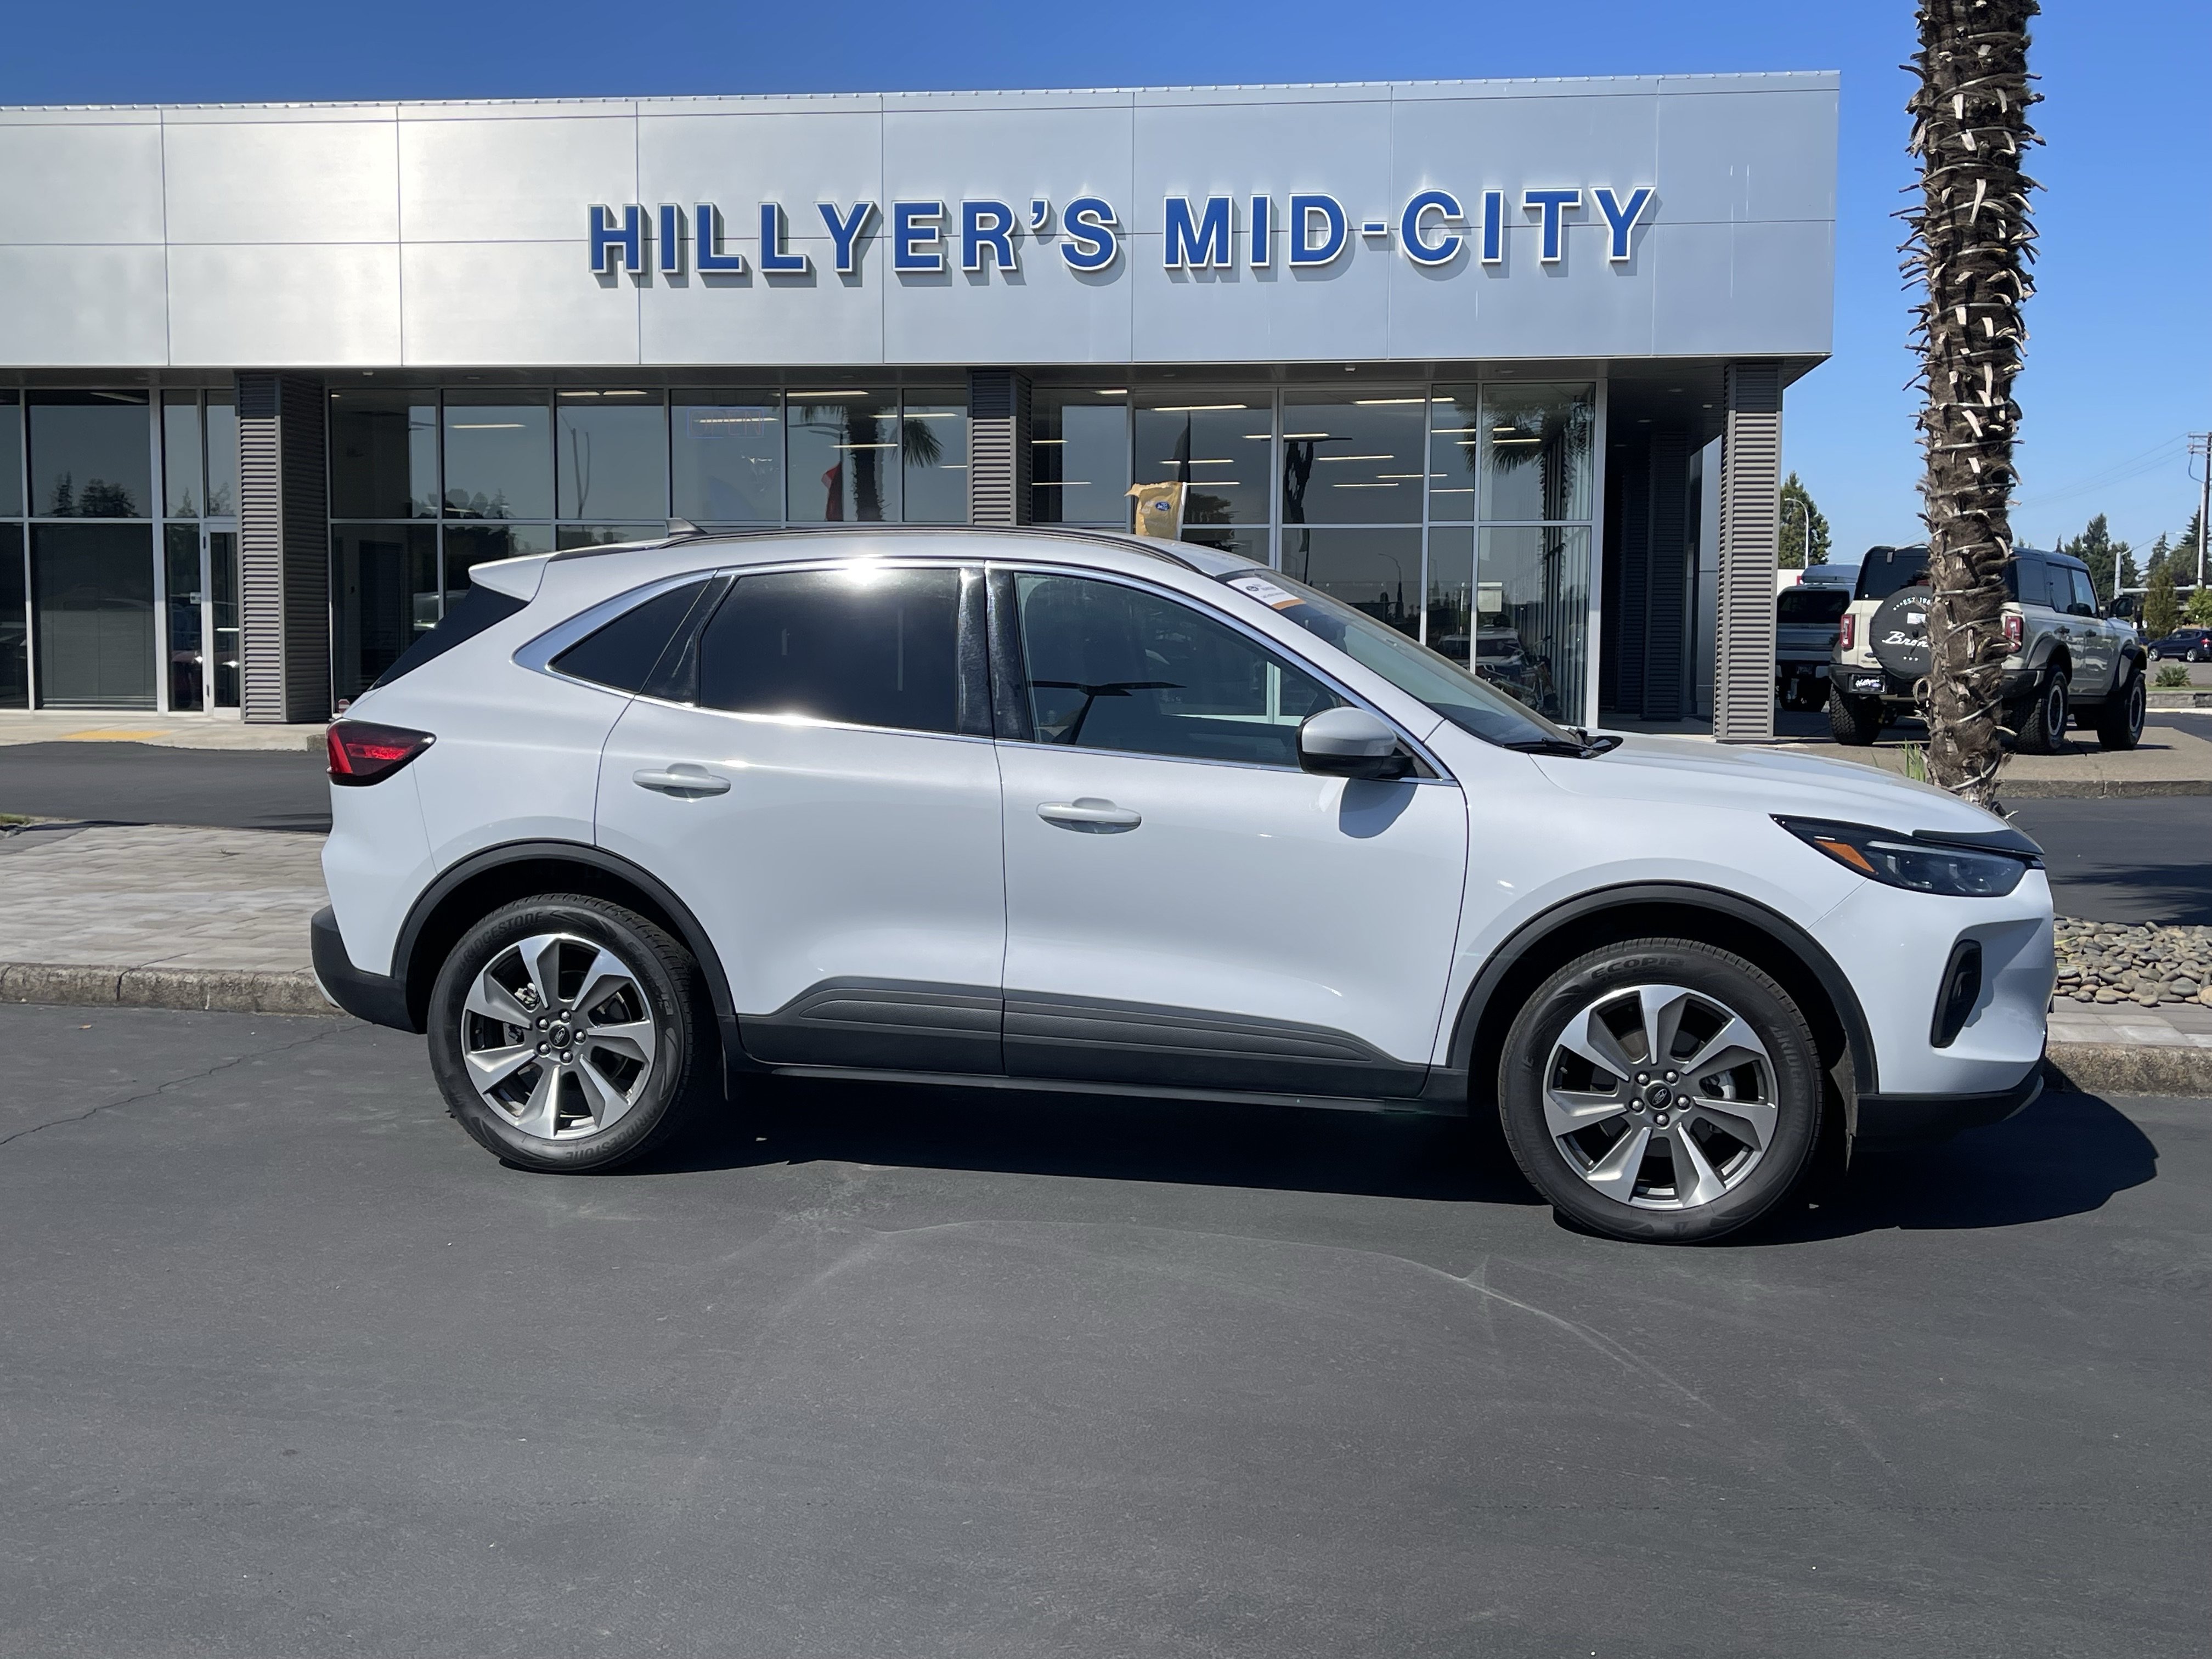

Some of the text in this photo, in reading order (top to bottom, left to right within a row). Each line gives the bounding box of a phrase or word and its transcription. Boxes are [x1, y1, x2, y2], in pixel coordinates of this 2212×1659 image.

[588, 186, 1656, 273] HILLYER'S MID-CITY
[1881, 631, 1929, 647] Bron
